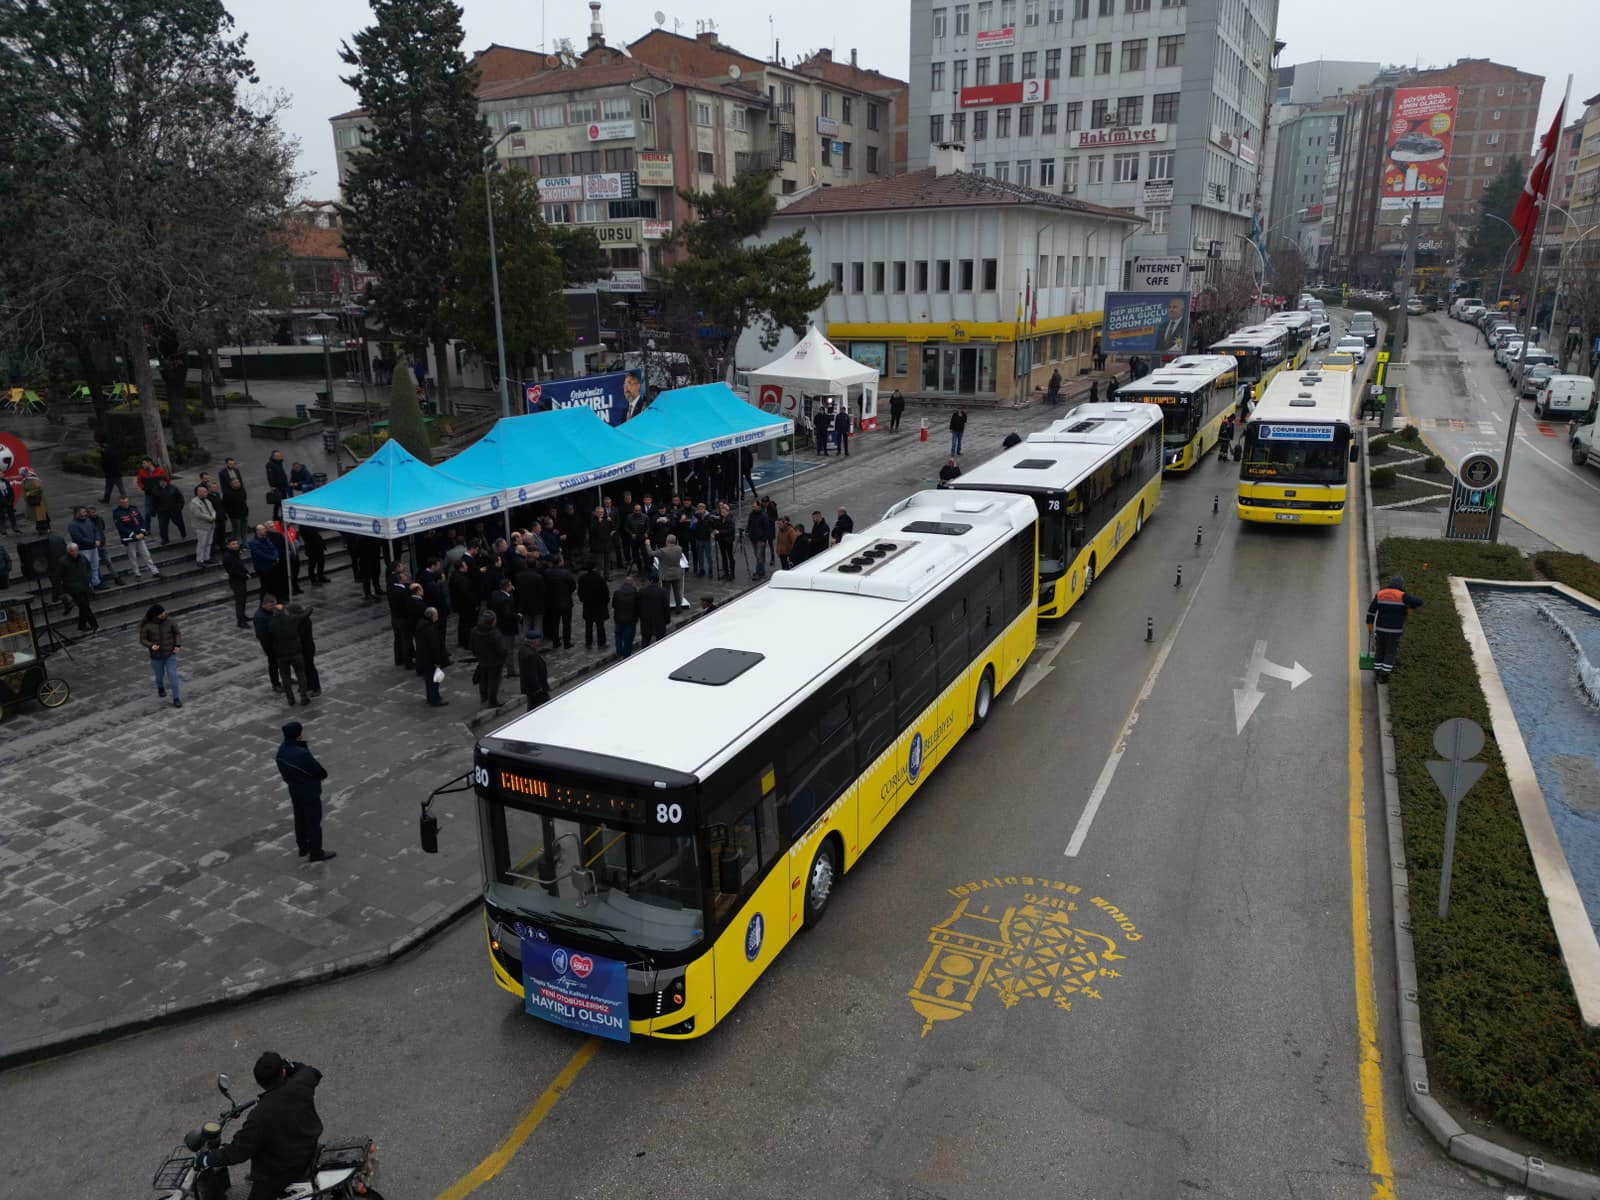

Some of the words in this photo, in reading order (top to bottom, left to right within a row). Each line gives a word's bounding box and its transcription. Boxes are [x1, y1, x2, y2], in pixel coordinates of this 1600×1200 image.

[587, 178, 619, 194] SRC
[1146, 276, 1169, 286] CAFE
[1109, 313, 1135, 323] DAHA
[1110, 308, 1126, 317] HEP
[1048, 500, 1060, 511] 78
[475, 765, 489, 788] 80
[656, 803, 682, 824] 80
[541, 988, 556, 998] YENİ
[531, 993, 575, 1018] HAYIRLI
[578, 1009, 623, 1029] OLSUN
